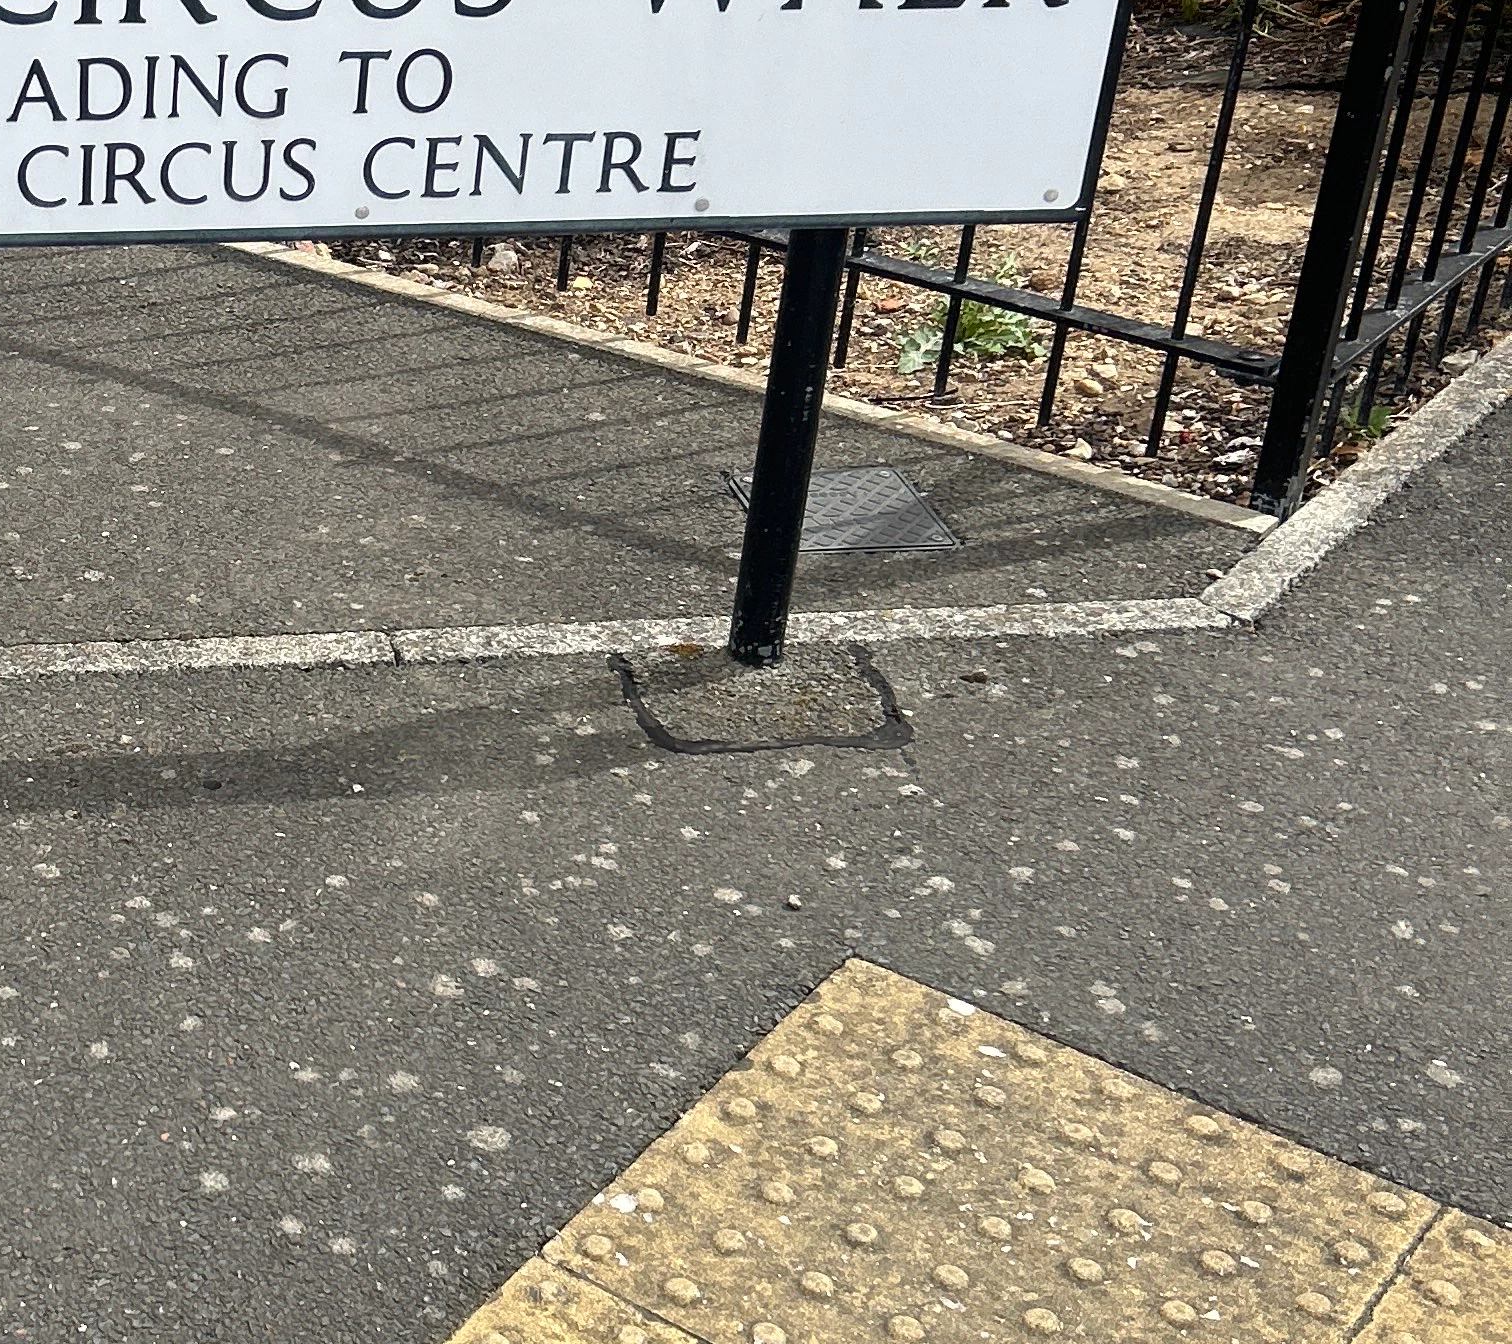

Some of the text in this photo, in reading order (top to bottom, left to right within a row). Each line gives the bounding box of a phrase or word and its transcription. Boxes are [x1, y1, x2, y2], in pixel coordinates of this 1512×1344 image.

[339, 49, 452, 113] TO
[18, 138, 316, 208] CIRCUS
[364, 130, 701, 199] CENTRE
